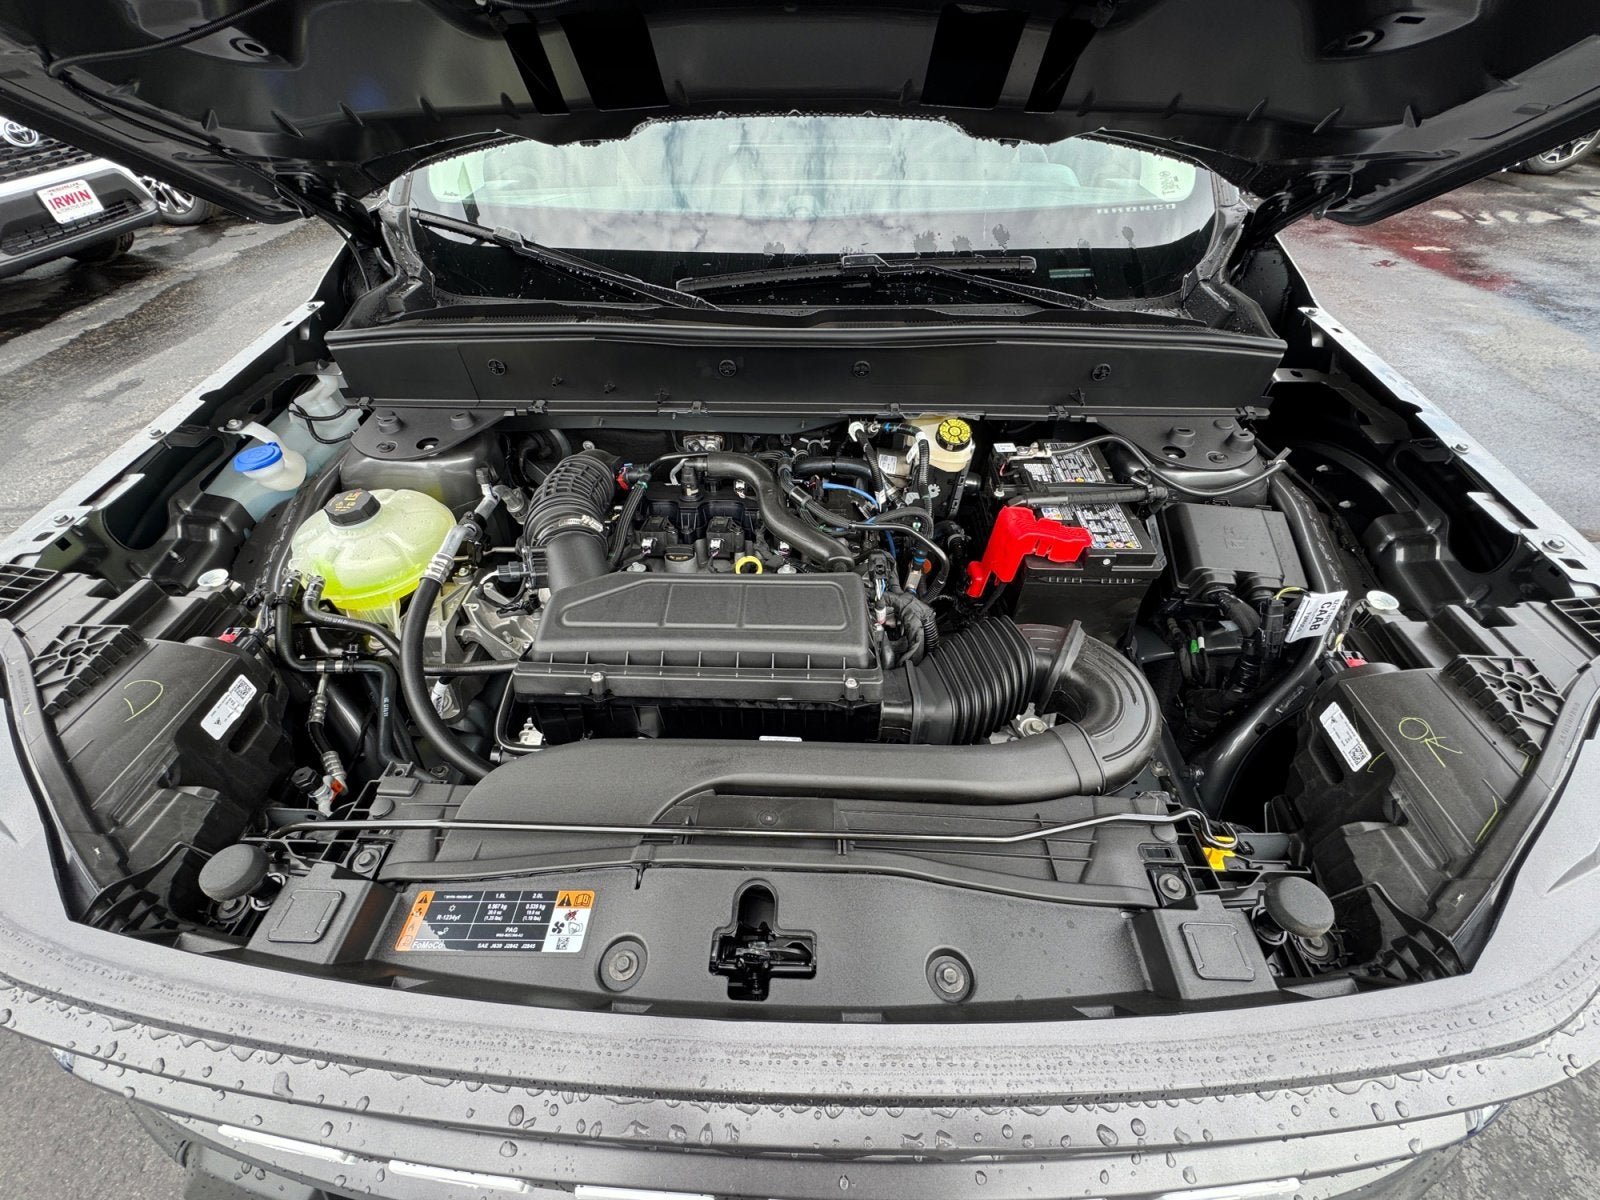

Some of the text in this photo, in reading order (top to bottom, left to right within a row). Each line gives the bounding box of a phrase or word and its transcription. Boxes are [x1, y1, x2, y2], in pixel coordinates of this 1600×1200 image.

[48, 189, 92, 211] IRWIN
[1309, 601, 1332, 630] CAAB
[436, 914, 461, 922] R-1234yf
[411, 941, 443, 950] FoMoCo
